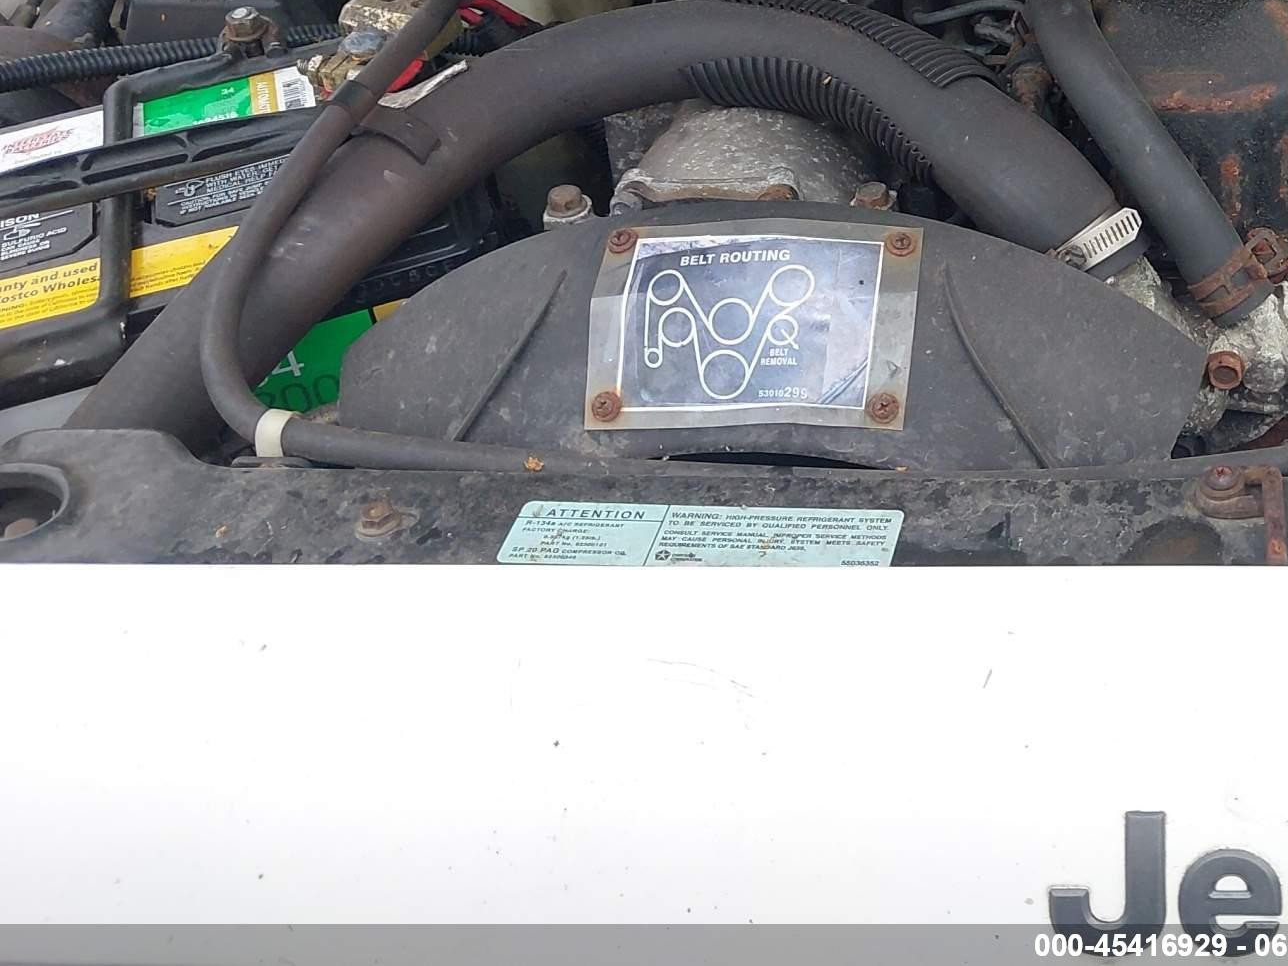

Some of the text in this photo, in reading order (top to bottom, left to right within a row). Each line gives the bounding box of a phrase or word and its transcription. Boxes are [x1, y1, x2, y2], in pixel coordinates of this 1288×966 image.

[0, 213, 39, 228] ISON
[680, 249, 790, 267] BELT ROUTING
[0, 262, 98, 292] nty and used
[0, 290, 38, 304] ostco
[770, 348, 788, 356] BELT
[760, 358, 798, 366] REMOVAL
[547, 509, 645, 520] ATTENTION
